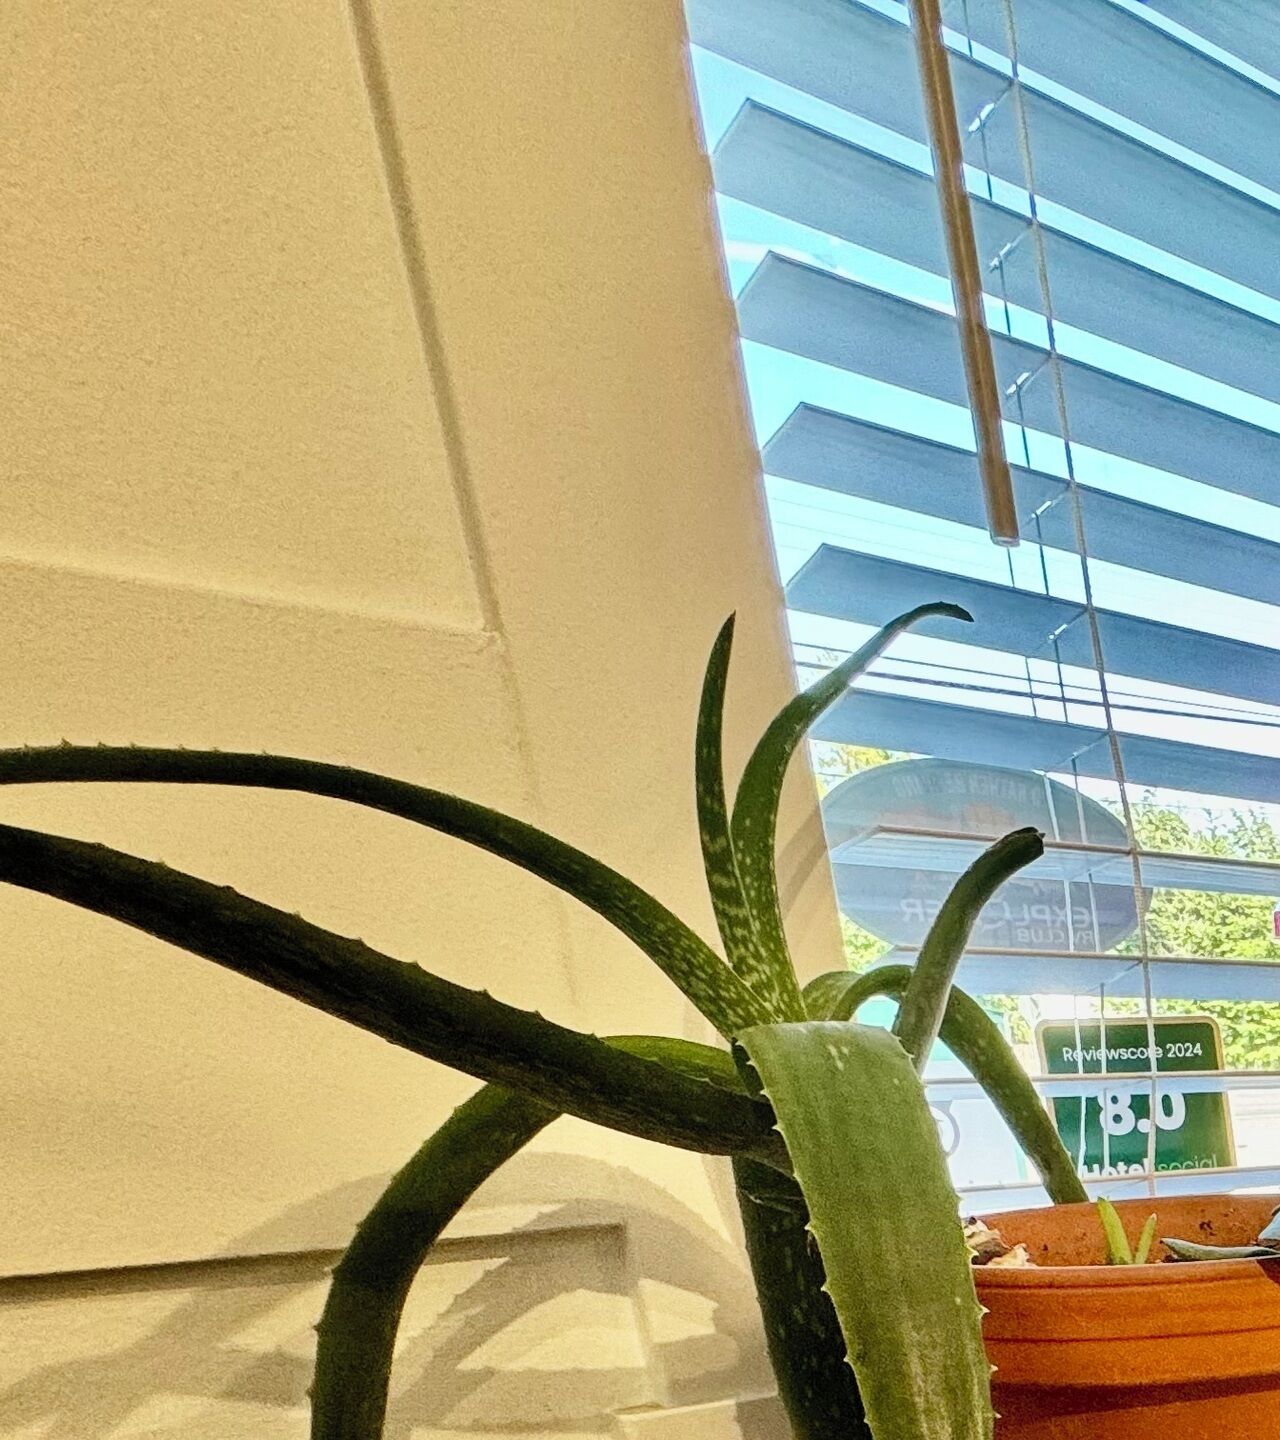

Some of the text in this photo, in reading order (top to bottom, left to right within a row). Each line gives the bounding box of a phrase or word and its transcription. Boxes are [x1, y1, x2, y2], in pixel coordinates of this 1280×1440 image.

[1062, 1042, 1203, 1062] Reviewscore 2024
[1100, 1088, 1186, 1136] 8.0
